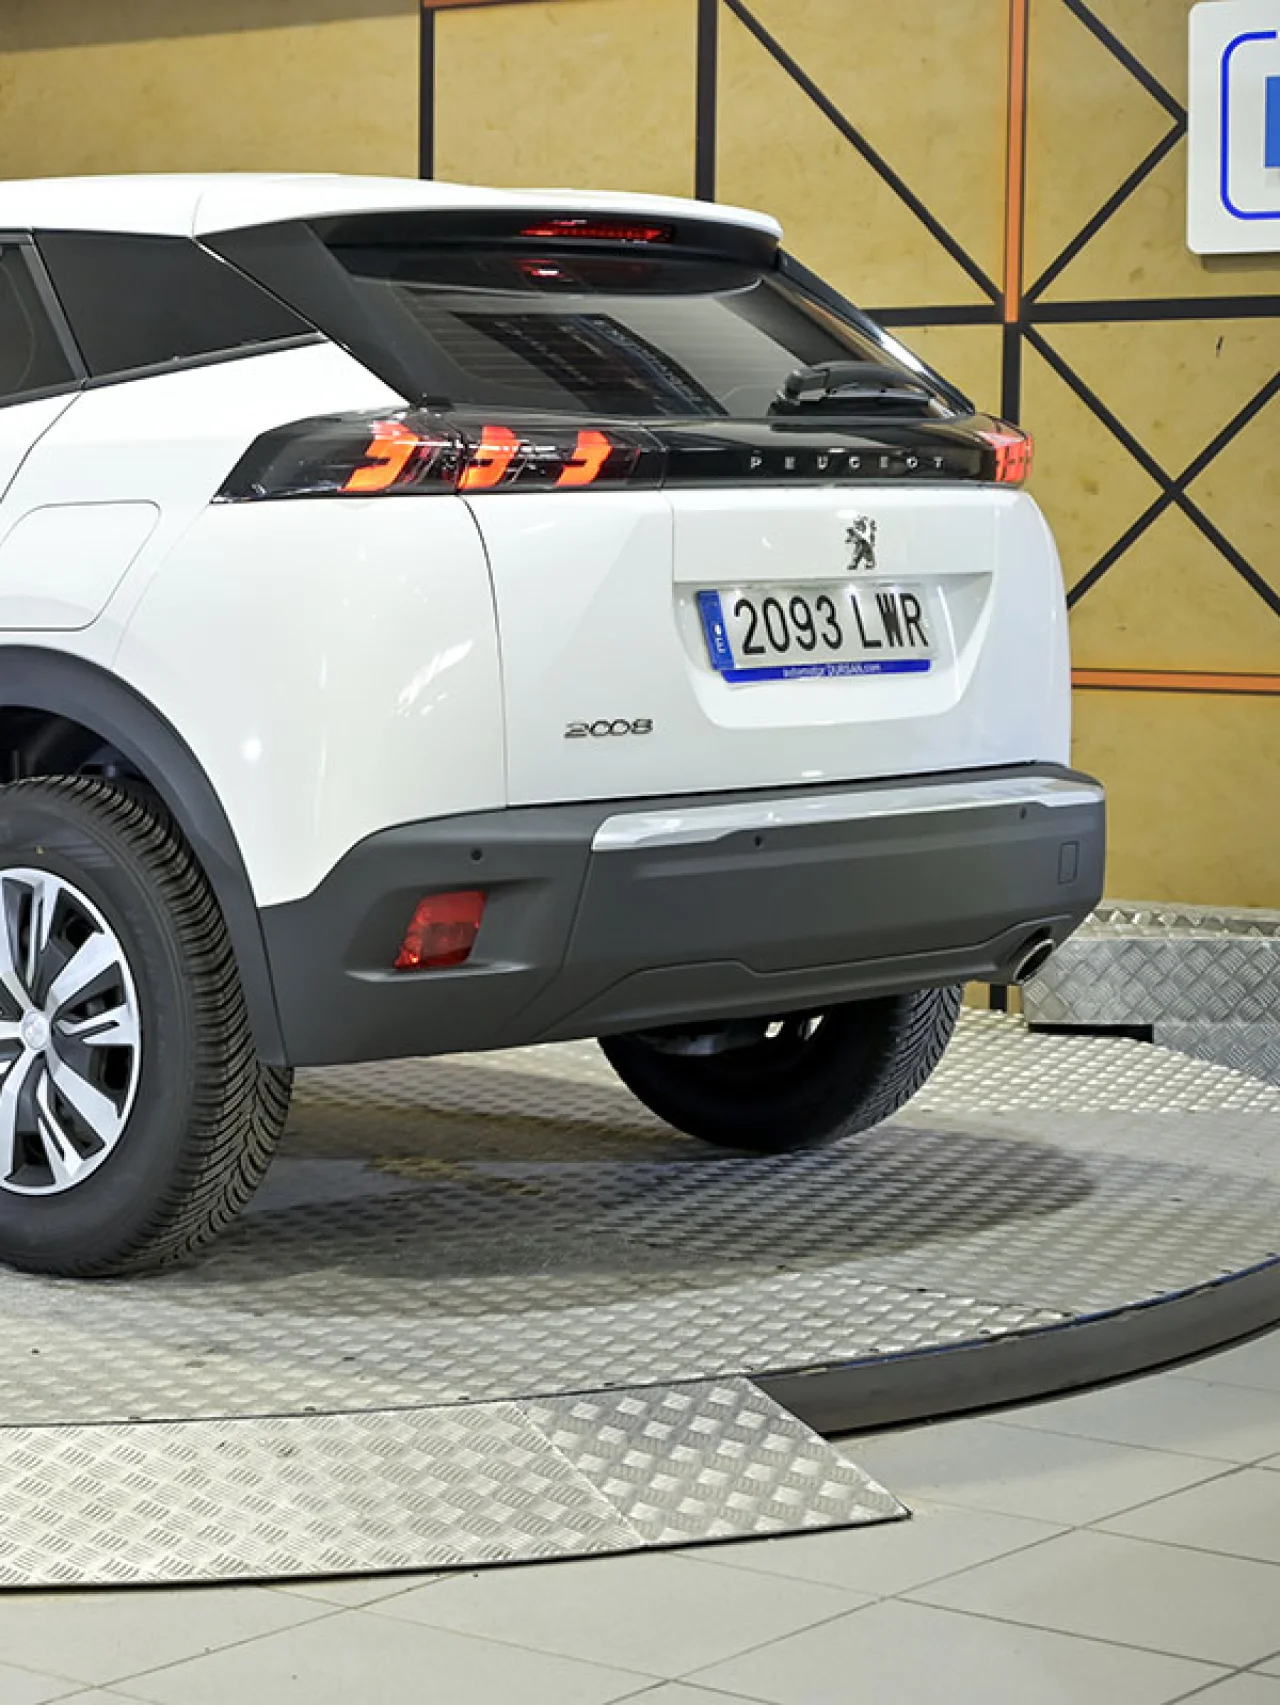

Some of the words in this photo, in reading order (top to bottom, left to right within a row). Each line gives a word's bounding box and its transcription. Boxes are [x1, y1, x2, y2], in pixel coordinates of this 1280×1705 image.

[750, 456, 944, 470] PEUGEOT
[733, 595, 843, 655] 2093
[850, 592, 929, 648] LWR
[564, 718, 653, 738] 2008
